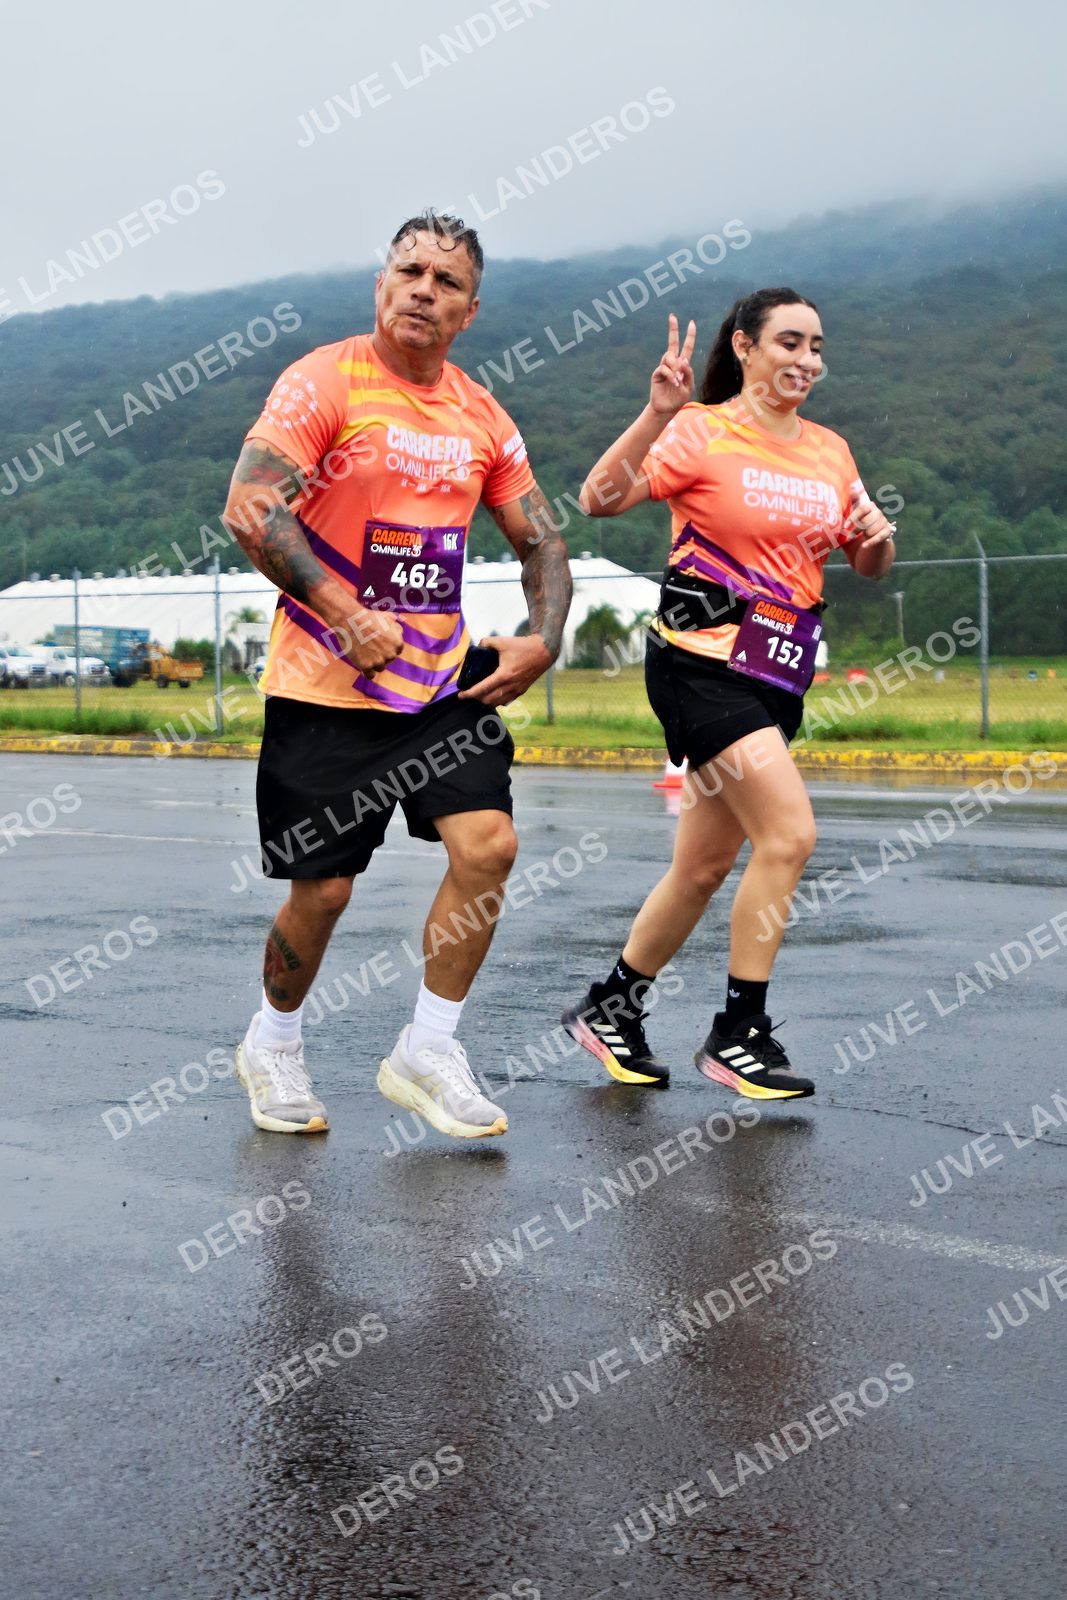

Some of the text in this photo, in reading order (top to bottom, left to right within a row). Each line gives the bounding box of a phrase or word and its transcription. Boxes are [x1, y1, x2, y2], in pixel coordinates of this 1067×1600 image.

[387, 424, 473, 462] CARRERA
[743, 467, 838, 505] CARRERA
[372, 528, 423, 546] CARRERA
[390, 562, 440, 588] 462
[754, 600, 798, 625] CARRERA
[767, 636, 804, 669] 152
